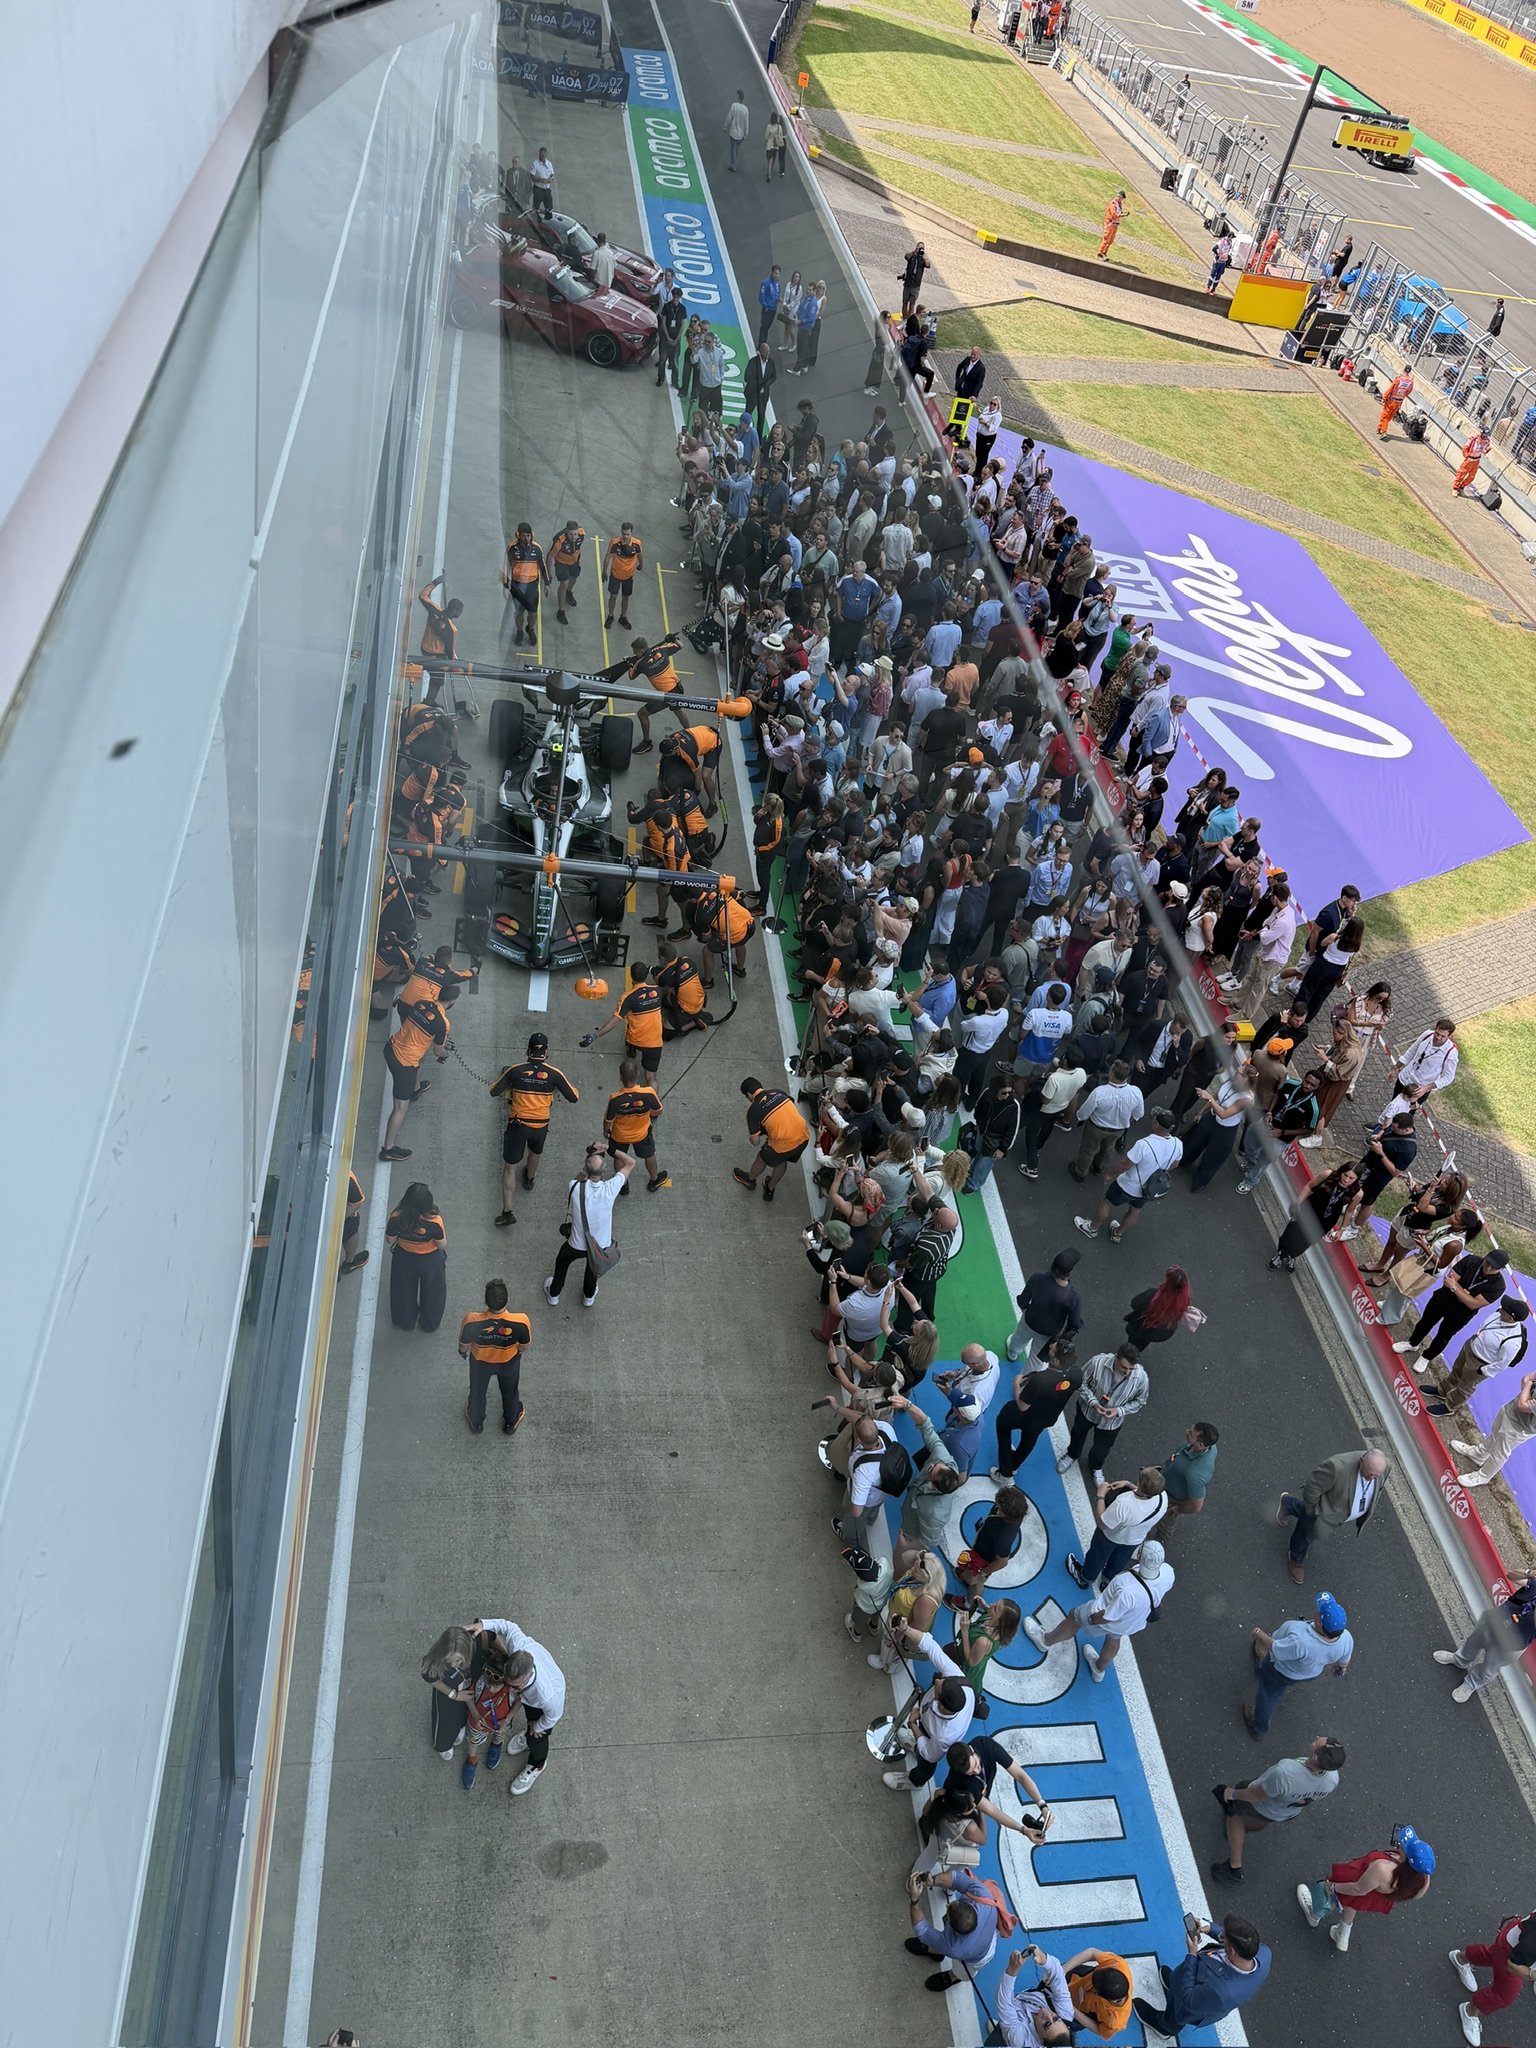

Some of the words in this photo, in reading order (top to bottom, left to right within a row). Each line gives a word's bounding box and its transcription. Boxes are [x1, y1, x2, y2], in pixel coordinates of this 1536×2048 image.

[530, 13, 557, 25] UAOA
[1454, 9, 1477, 31] PIRELLI
[1485, 25, 1510, 49] PIRELLI
[523, 63, 538, 74] 07
[633, 54, 670, 100] aramco
[551, 74, 582, 90] UAOA
[586, 73, 609, 94] Day
[609, 76, 624, 88] 07
[1353, 128, 1399, 148] PIRELLI
[643, 117, 691, 190] aramco
[663, 212, 721, 305] aramco
[1143, 533, 1413, 781] Vegas
[689, 702, 716, 712] WORLD
[687, 881, 718, 890] WORLD
[1043, 1021, 1061, 1029] VISA
[1353, 1291, 1376, 1323] KitKat
[1394, 1380, 1419, 1415] KitKat
[1441, 1480, 1469, 1517] KitKat
